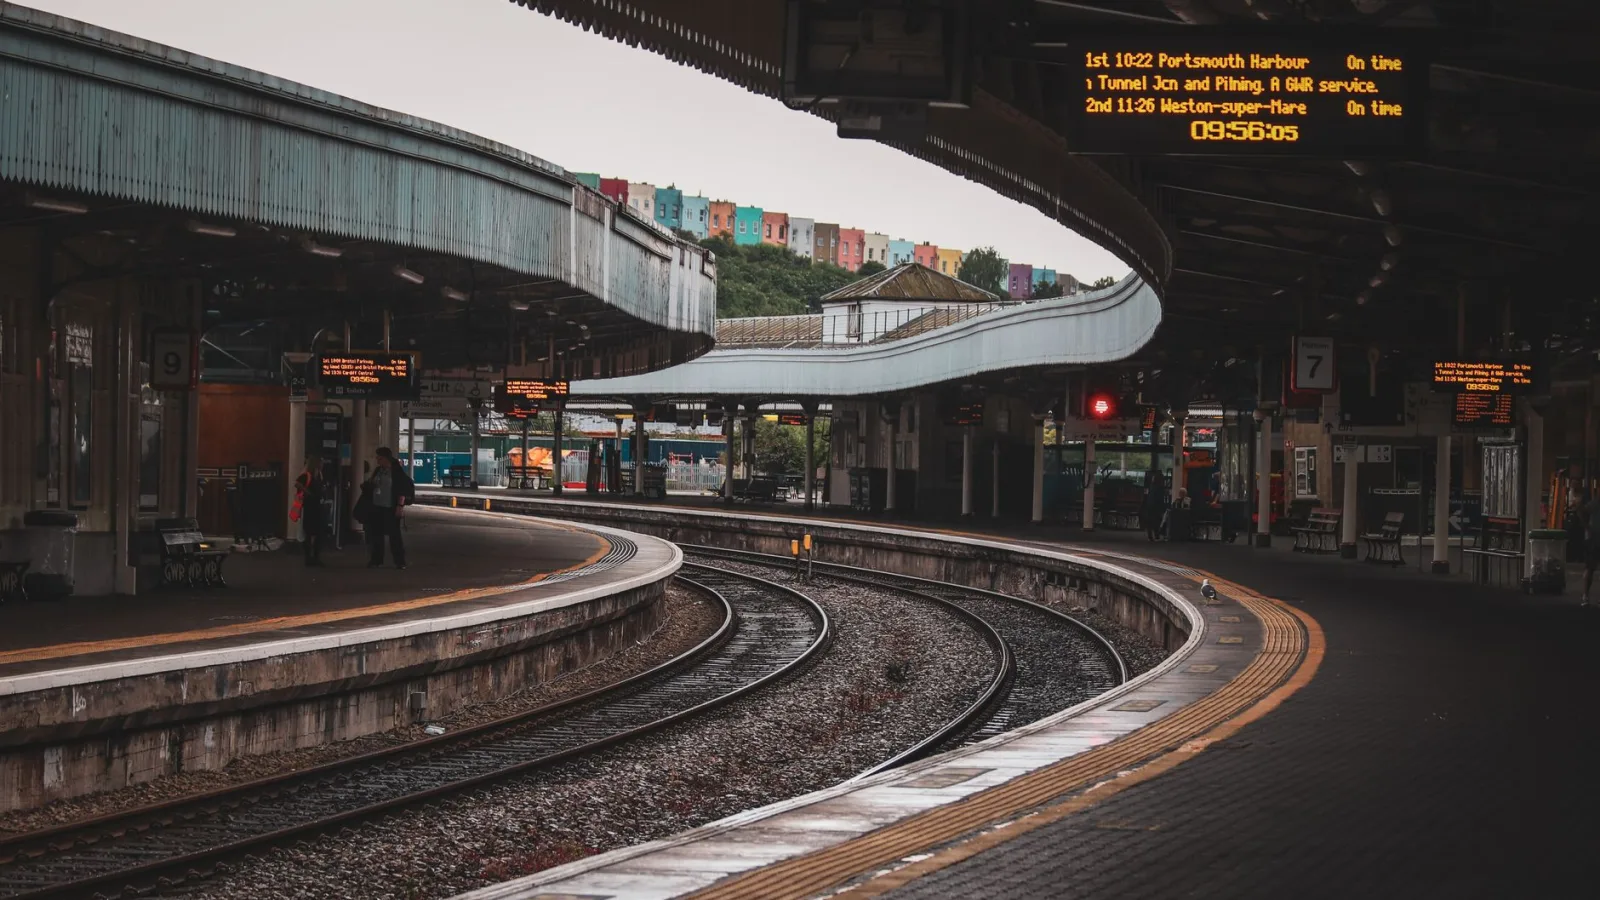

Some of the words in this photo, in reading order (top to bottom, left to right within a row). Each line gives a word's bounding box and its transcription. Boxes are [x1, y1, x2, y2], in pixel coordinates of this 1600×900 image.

[1086, 52, 1109, 67] 1st
[1116, 52, 1153, 68] 10:22
[1159, 53, 1245, 68] Portsmouth
[1250, 54, 1310, 69] Harbour
[1347, 55, 1365, 70] On
[1371, 55, 1402, 70] time
[1098, 76, 1147, 90] Tunnel
[1152, 76, 1178, 91] Jcn
[1184, 76, 1210, 91] and
[1215, 76, 1265, 95] Pilning.
[1271, 77, 1280, 91] A
[1286, 77, 1313, 92] GWR
[1319, 78, 1378, 93] service.
[1086, 98, 1112, 113] 2nd
[1117, 98, 1155, 113] 11:26
[1161, 99, 1307, 117] Weston-super-Mare
[1347, 100, 1365, 115] On
[1371, 100, 1402, 116] time
[1191, 121, 1298, 141] 09:56:05
[164, 352, 181, 375] 9
[1307, 355, 1323, 379] 7
[431, 382, 449, 392] Lift
[164, 562, 185, 582] GWR
